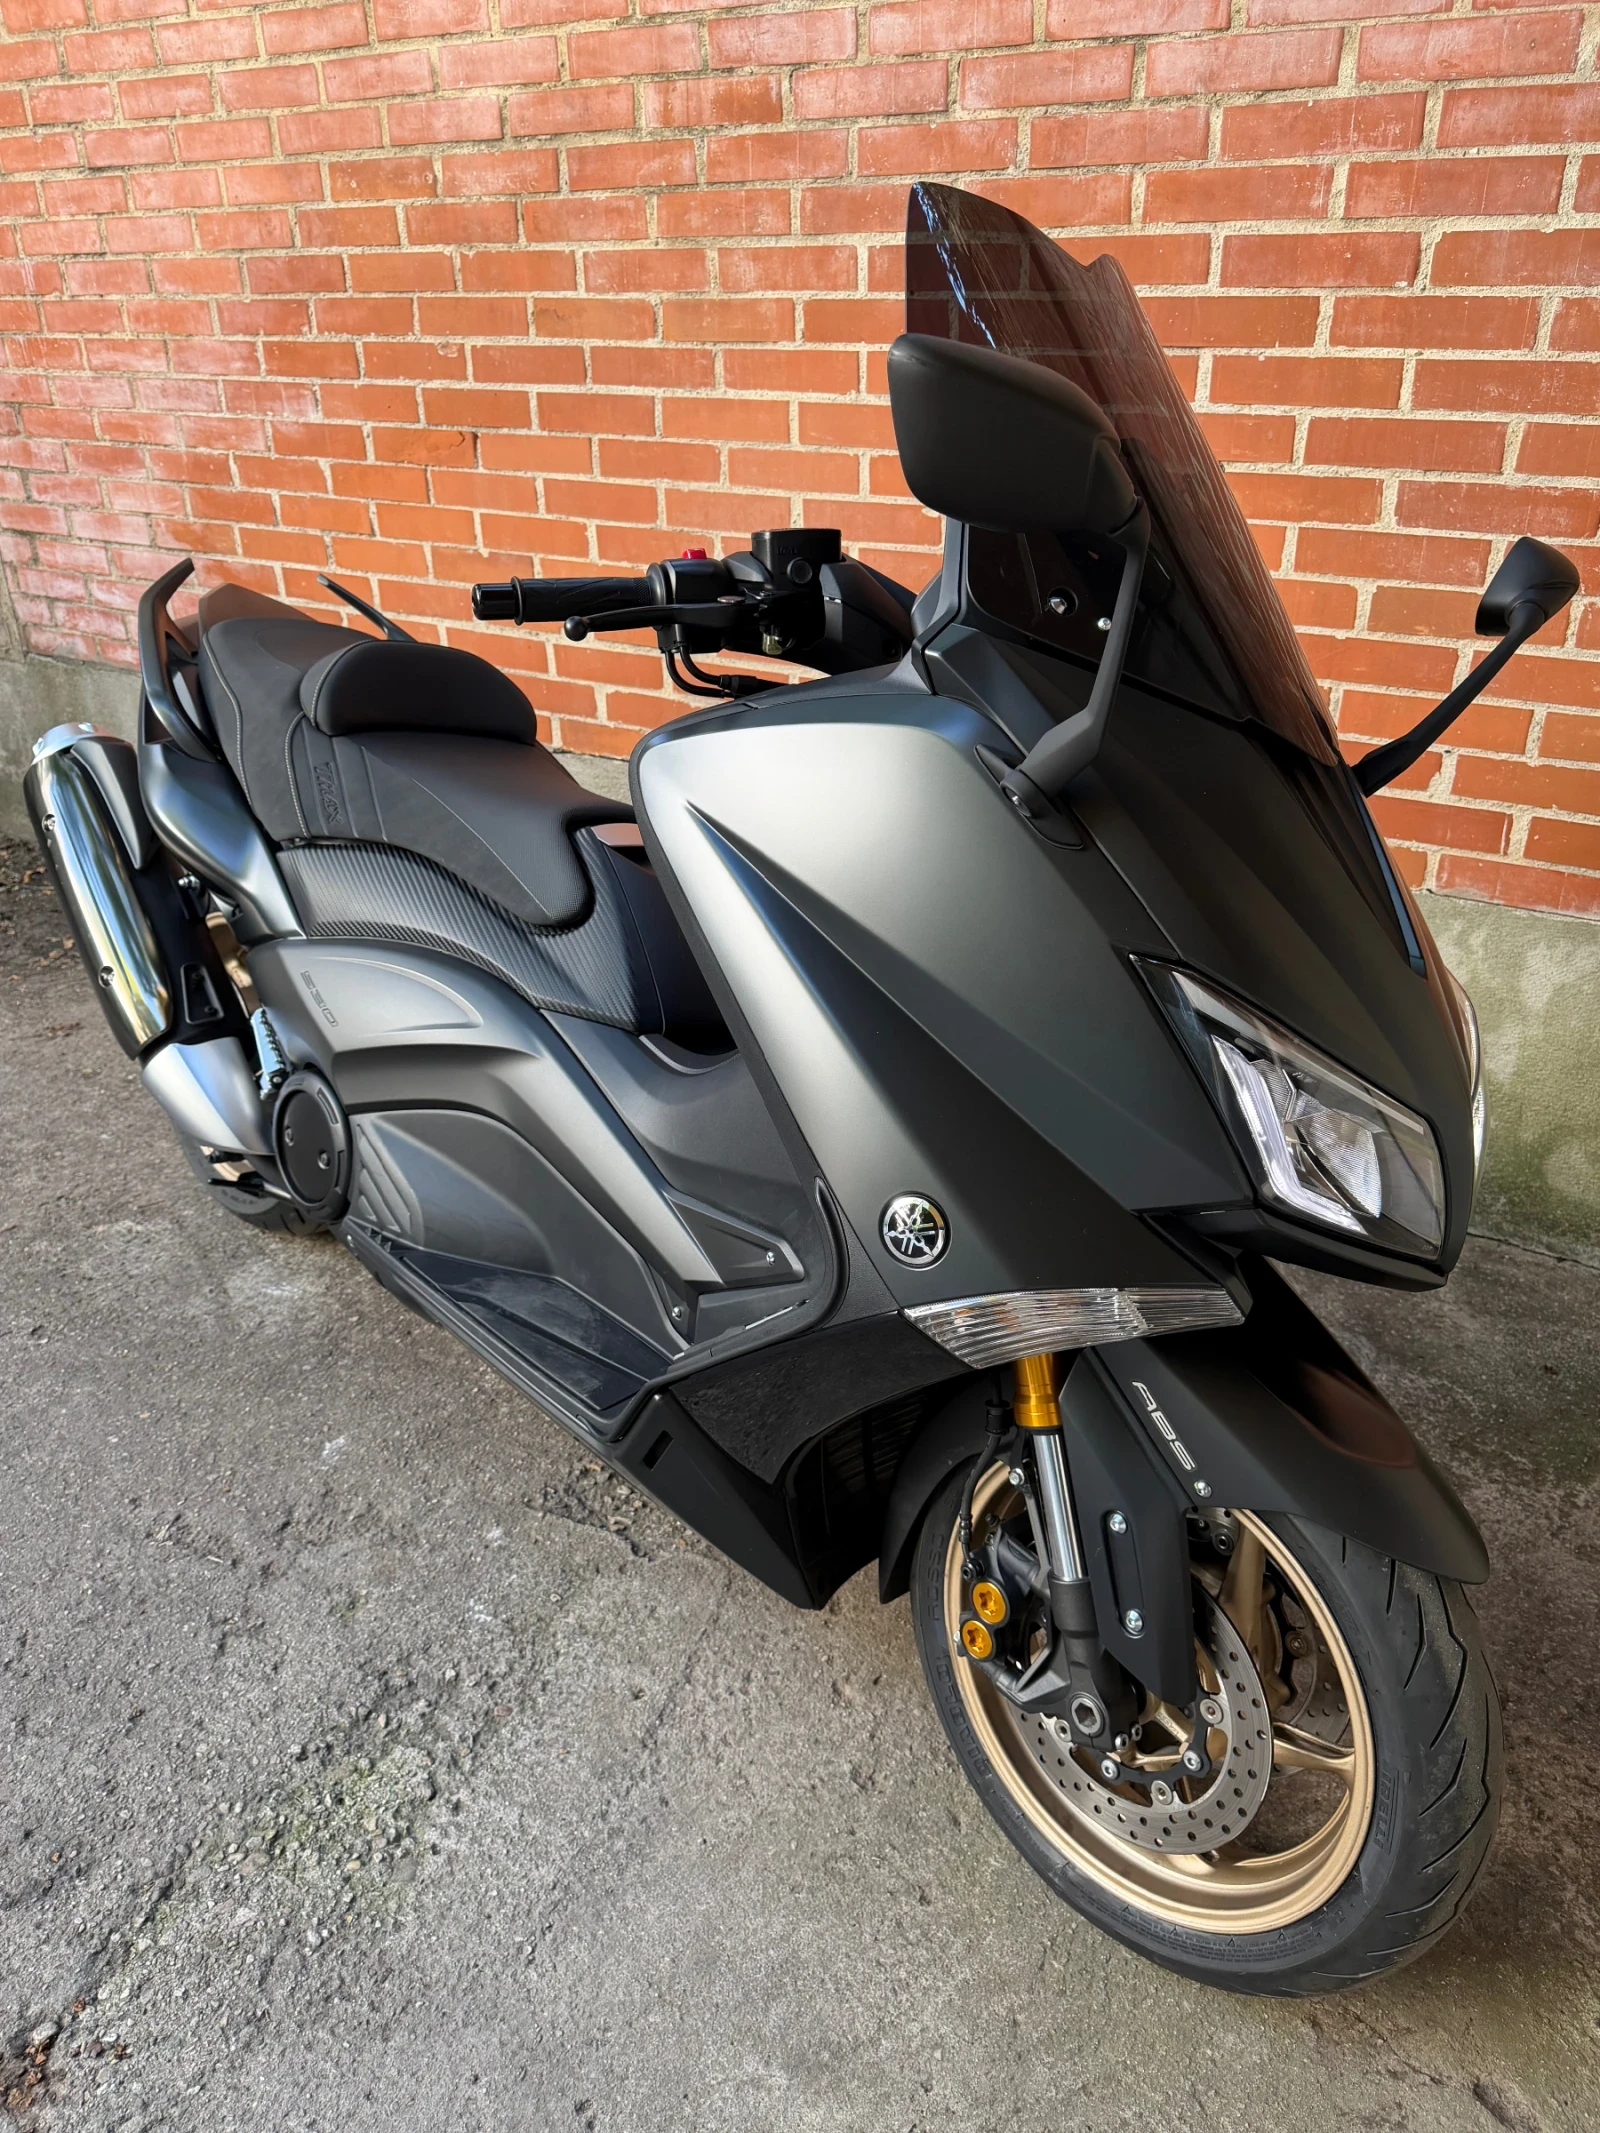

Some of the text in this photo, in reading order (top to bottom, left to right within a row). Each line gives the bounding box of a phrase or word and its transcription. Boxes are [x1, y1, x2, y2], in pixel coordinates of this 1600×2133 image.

[301, 970, 338, 1027] 530
[1132, 1381, 1195, 1470] ABS
[928, 1532, 992, 1777] DIABLO ROSSO
